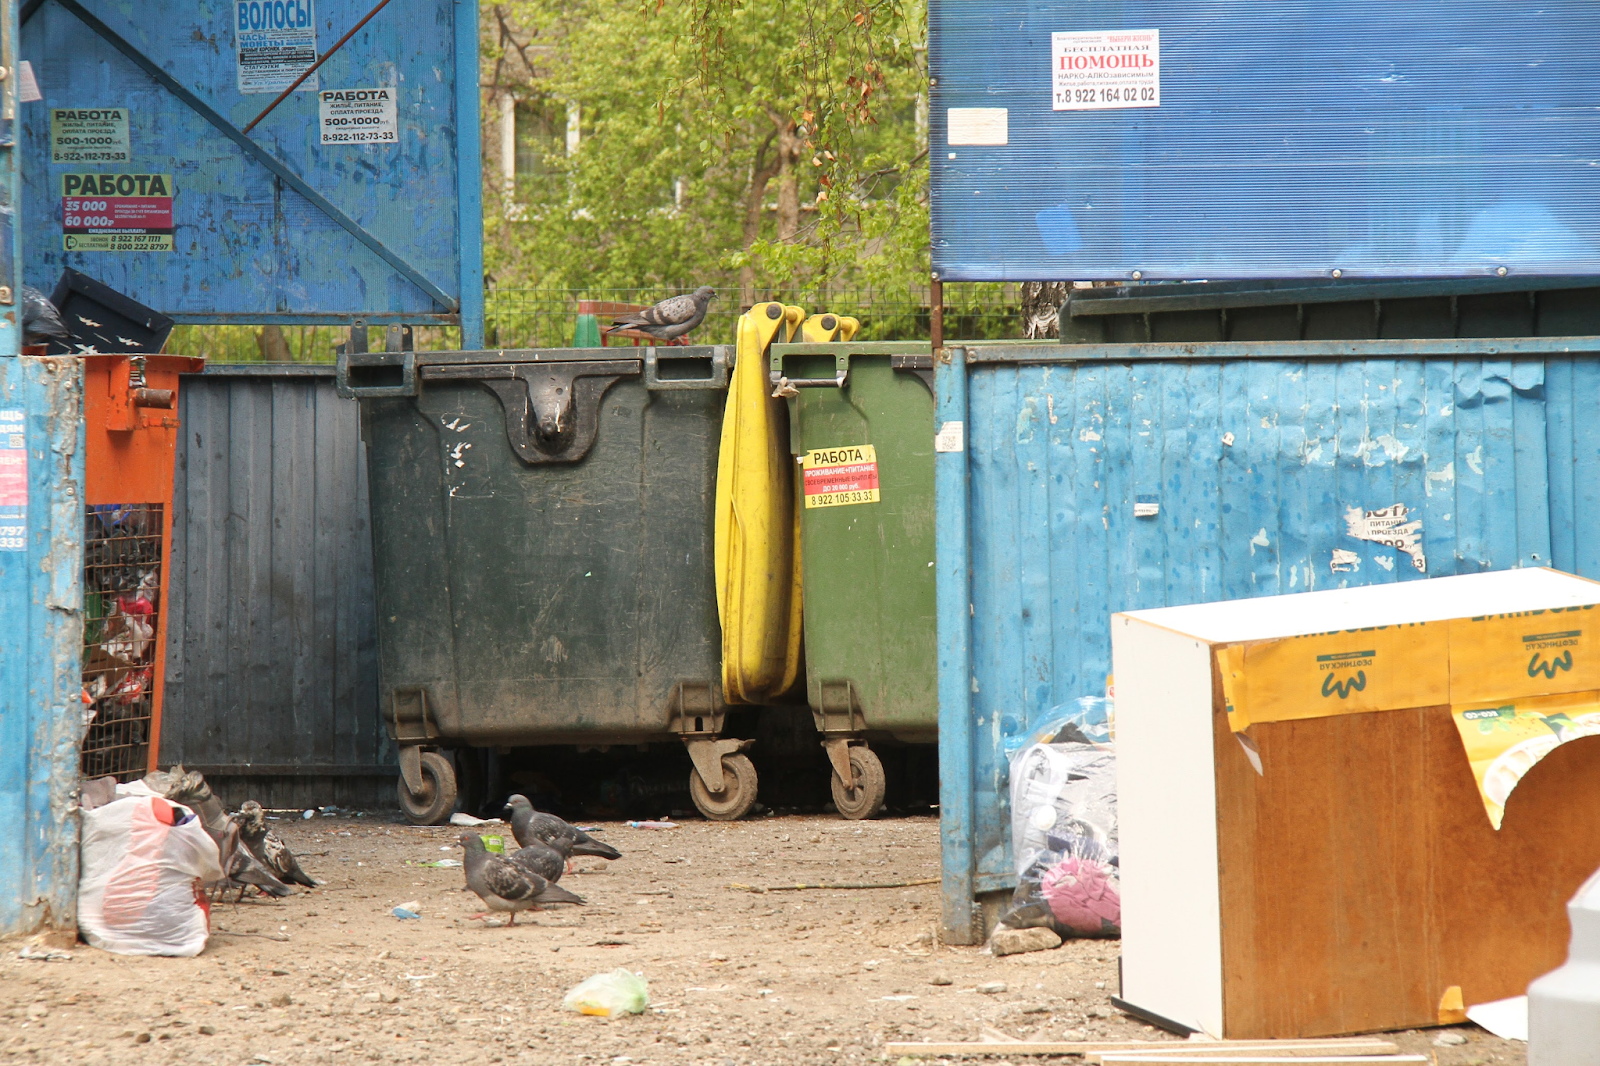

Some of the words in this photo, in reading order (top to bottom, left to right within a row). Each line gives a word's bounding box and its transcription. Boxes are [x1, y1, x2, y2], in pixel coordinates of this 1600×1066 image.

[238, 0, 311, 30] ВОЛОСЫ
[1064, 45, 1149, 53] БЕСПЛАТНАЯ
[1059, 53, 1154, 70] ПОМОЩЬ
[1058, 72, 1154, 80] НАРКО-АЛКОзависимым
[323, 90, 389, 101] РАБОТА
[1075, 88, 1096, 103] 922
[1099, 88, 1120, 102] 164
[1123, 87, 1137, 101] 02
[1141, 87, 1155, 101] 02
[55, 110, 122, 120] РАБОТА
[325, 117, 380, 126] 500-1000
[56, 137, 112, 145] 500-1000
[323, 131, 394, 141] 8-922-112-73-33
[54, 152, 126, 161] 8-922-112-73-33
[64, 174, 168, 196] РАБОТА
[65, 200, 80, 211] 35
[82, 200, 107, 211] 000
[65, 215, 81, 226] 60
[814, 449, 863, 465] РАБОТА
[822, 485, 831, 493] ДО
[848, 482, 860, 490] руб.
[811, 496, 816, 506] 8
[818, 495, 833, 505] 922
[835, 493, 850, 504] 105
[851, 492, 862, 502] 33
[1525, 639, 1579, 651] РЕФТИНСКАЯ
[1319, 658, 1372, 671] РЕФТИНСКАЯ
